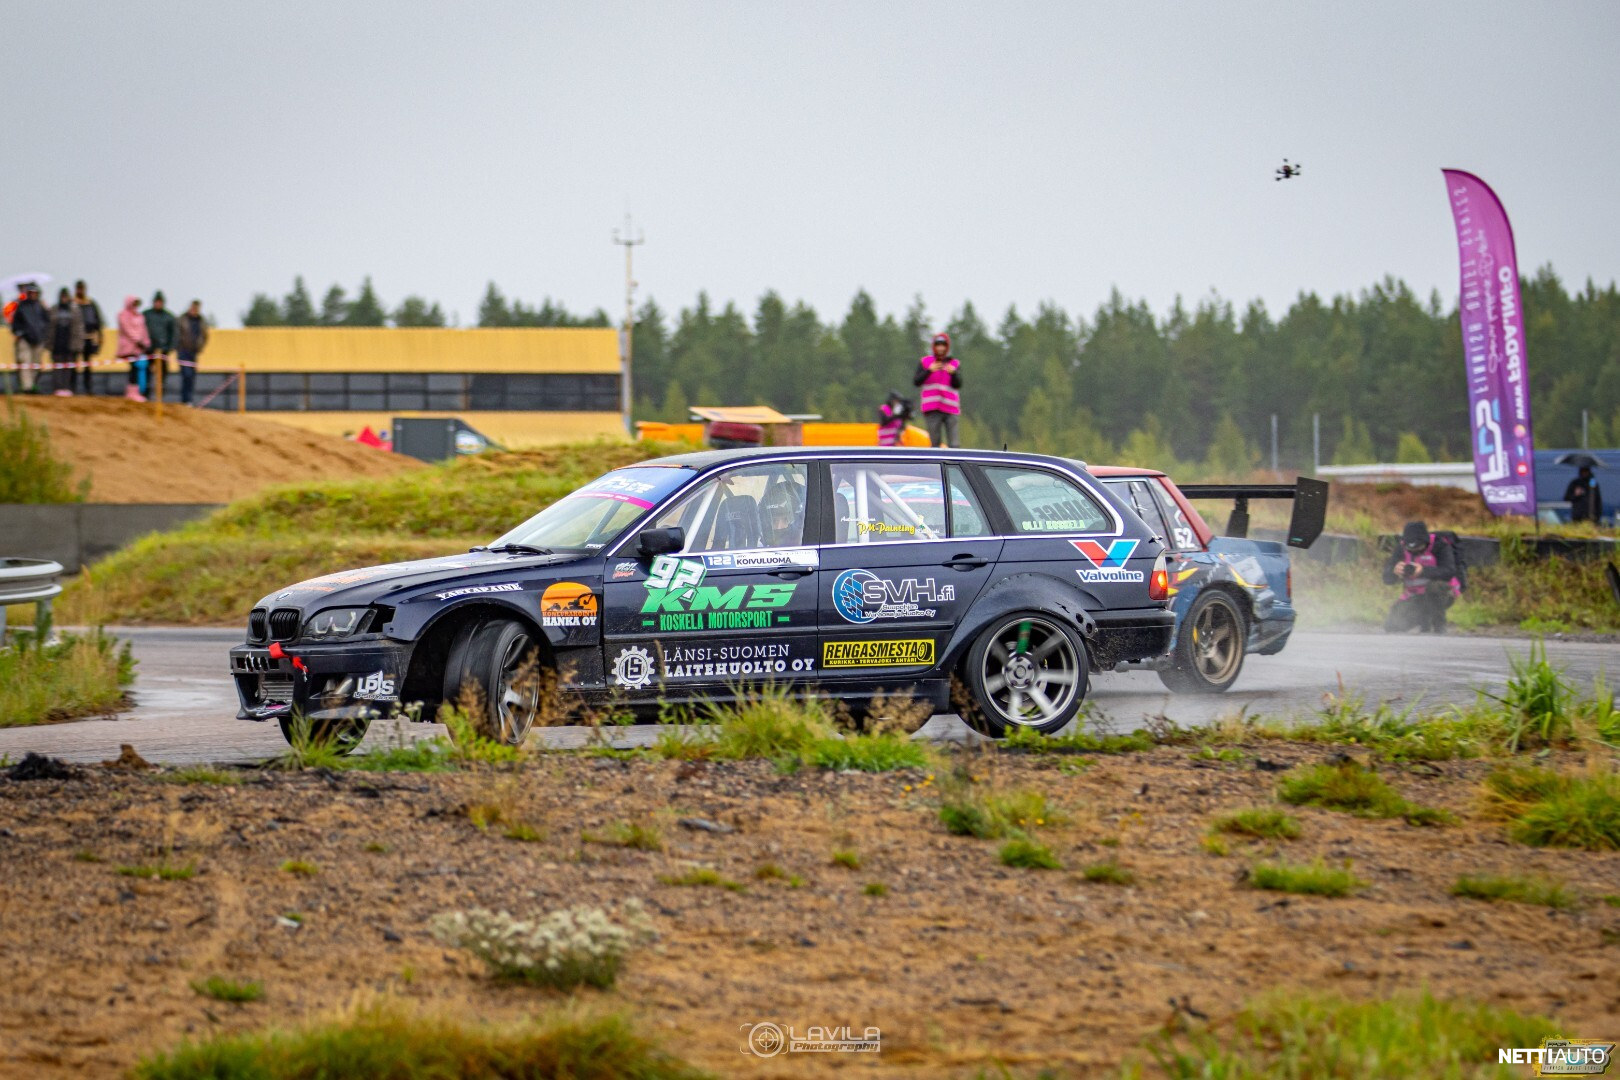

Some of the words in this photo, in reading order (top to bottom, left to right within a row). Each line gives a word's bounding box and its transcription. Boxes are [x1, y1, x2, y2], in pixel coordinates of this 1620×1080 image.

[857, 522, 915, 535] PM-Painting
[1173, 527, 1195, 549] 52
[707, 556, 732, 566] 122
[736, 556, 792, 566] KOIVULUOMA
[643, 555, 707, 601] 92
[1078, 570, 1143, 581] Valvoline
[641, 584, 797, 613] KMS
[863, 578, 955, 604] SVH.fi
[542, 616, 581, 627] HANKA
[581, 616, 597, 626] OY
[660, 612, 704, 631] KOSKELA
[708, 610, 773, 629] MOTORSPORT
[663, 644, 790, 663] LÄNSI-SUOMEN
[663, 660, 787, 678] LAITEHUOLTO
[791, 658, 815, 672] OY
